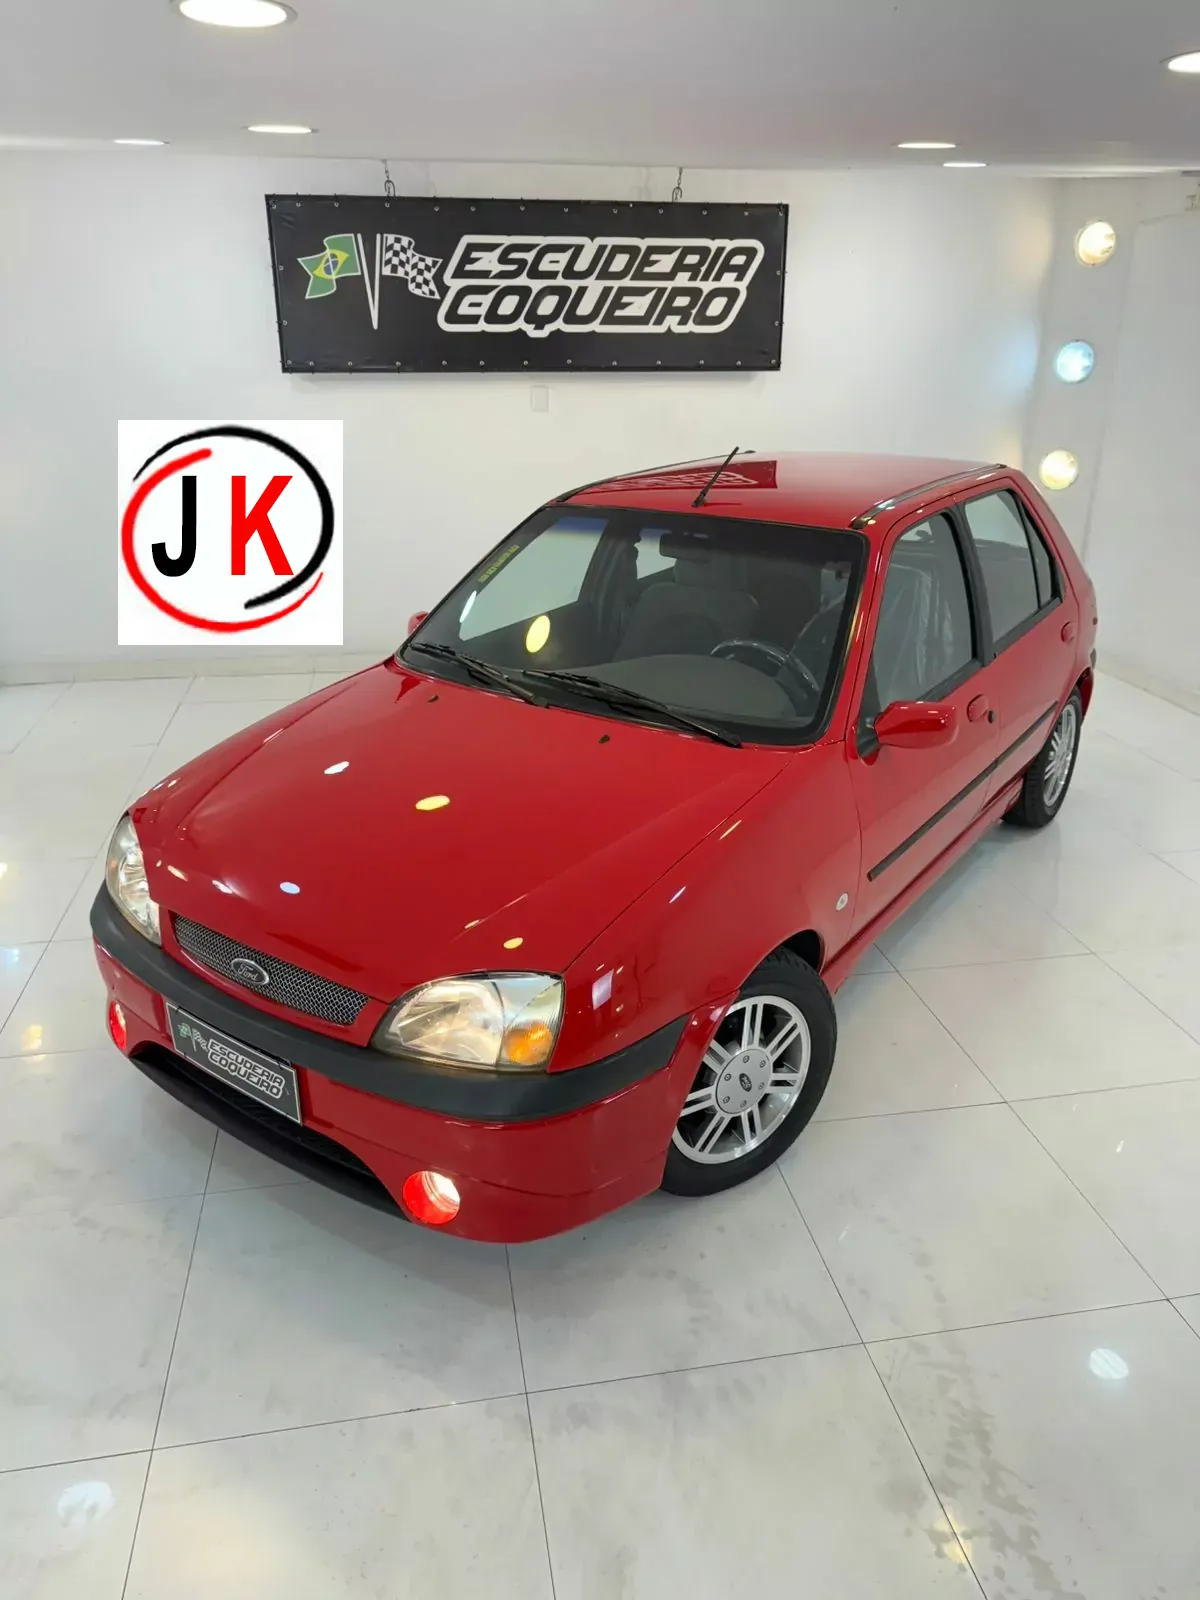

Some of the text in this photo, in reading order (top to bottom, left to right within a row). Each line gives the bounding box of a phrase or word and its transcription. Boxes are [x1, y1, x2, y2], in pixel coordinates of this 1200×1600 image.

[450, 242, 759, 282] ESCUDERIA
[443, 285, 741, 330] COQUEIRO
[237, 963, 260, 980] Ford
[209, 1041, 284, 1087] ESCUDERIA
[209, 1051, 281, 1097] COQUEIRO
